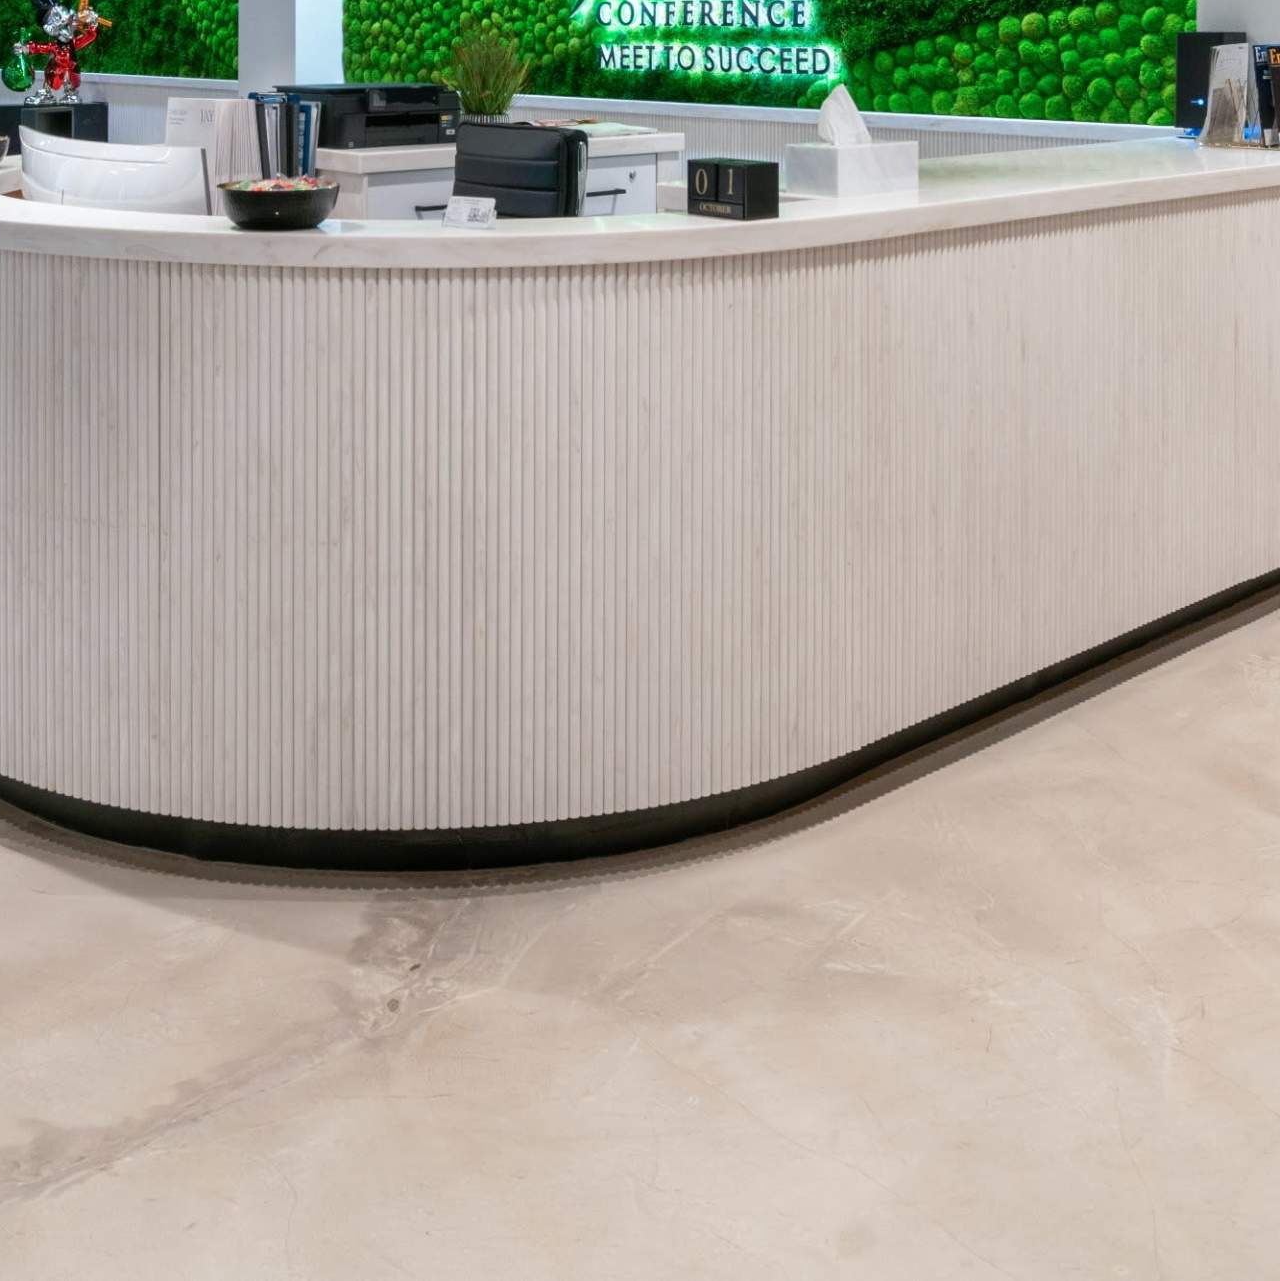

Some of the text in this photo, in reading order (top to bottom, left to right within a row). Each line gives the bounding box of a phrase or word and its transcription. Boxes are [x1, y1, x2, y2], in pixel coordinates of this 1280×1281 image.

[596, 0, 806, 28] CONFERENCE
[599, 44, 831, 76] MEET TO SUCCEED
